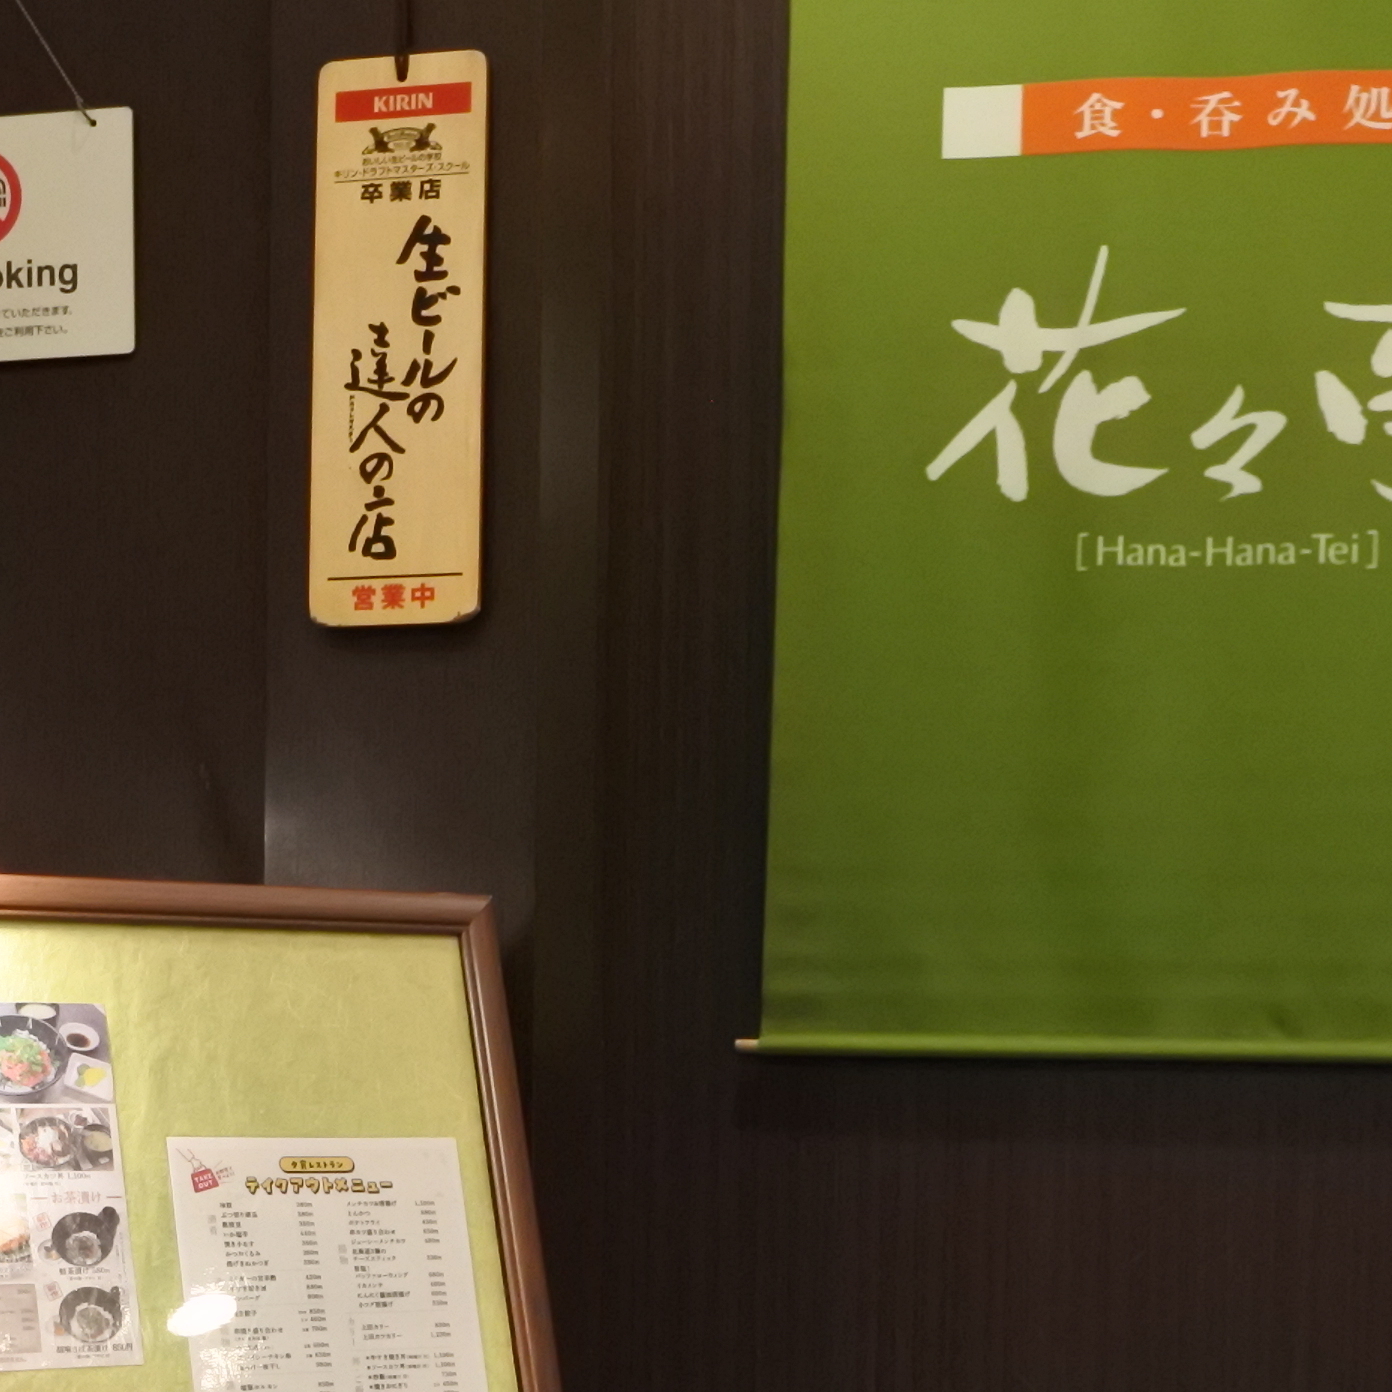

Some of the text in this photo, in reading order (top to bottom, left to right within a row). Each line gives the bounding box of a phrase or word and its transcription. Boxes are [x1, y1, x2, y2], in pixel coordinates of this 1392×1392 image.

[373, 92, 434, 113] KIRIN
[360, 178, 442, 204] 卒業店
[395, 214, 461, 424] 生ビールの
[343, 321, 411, 561] 達人の店
[351, 582, 435, 611] 営業中
[197, 1181, 214, 1190] OUT
[244, 1176, 394, 1196] テイクアウトメニュー
[51, 1191, 101, 1205] お茶漬け
